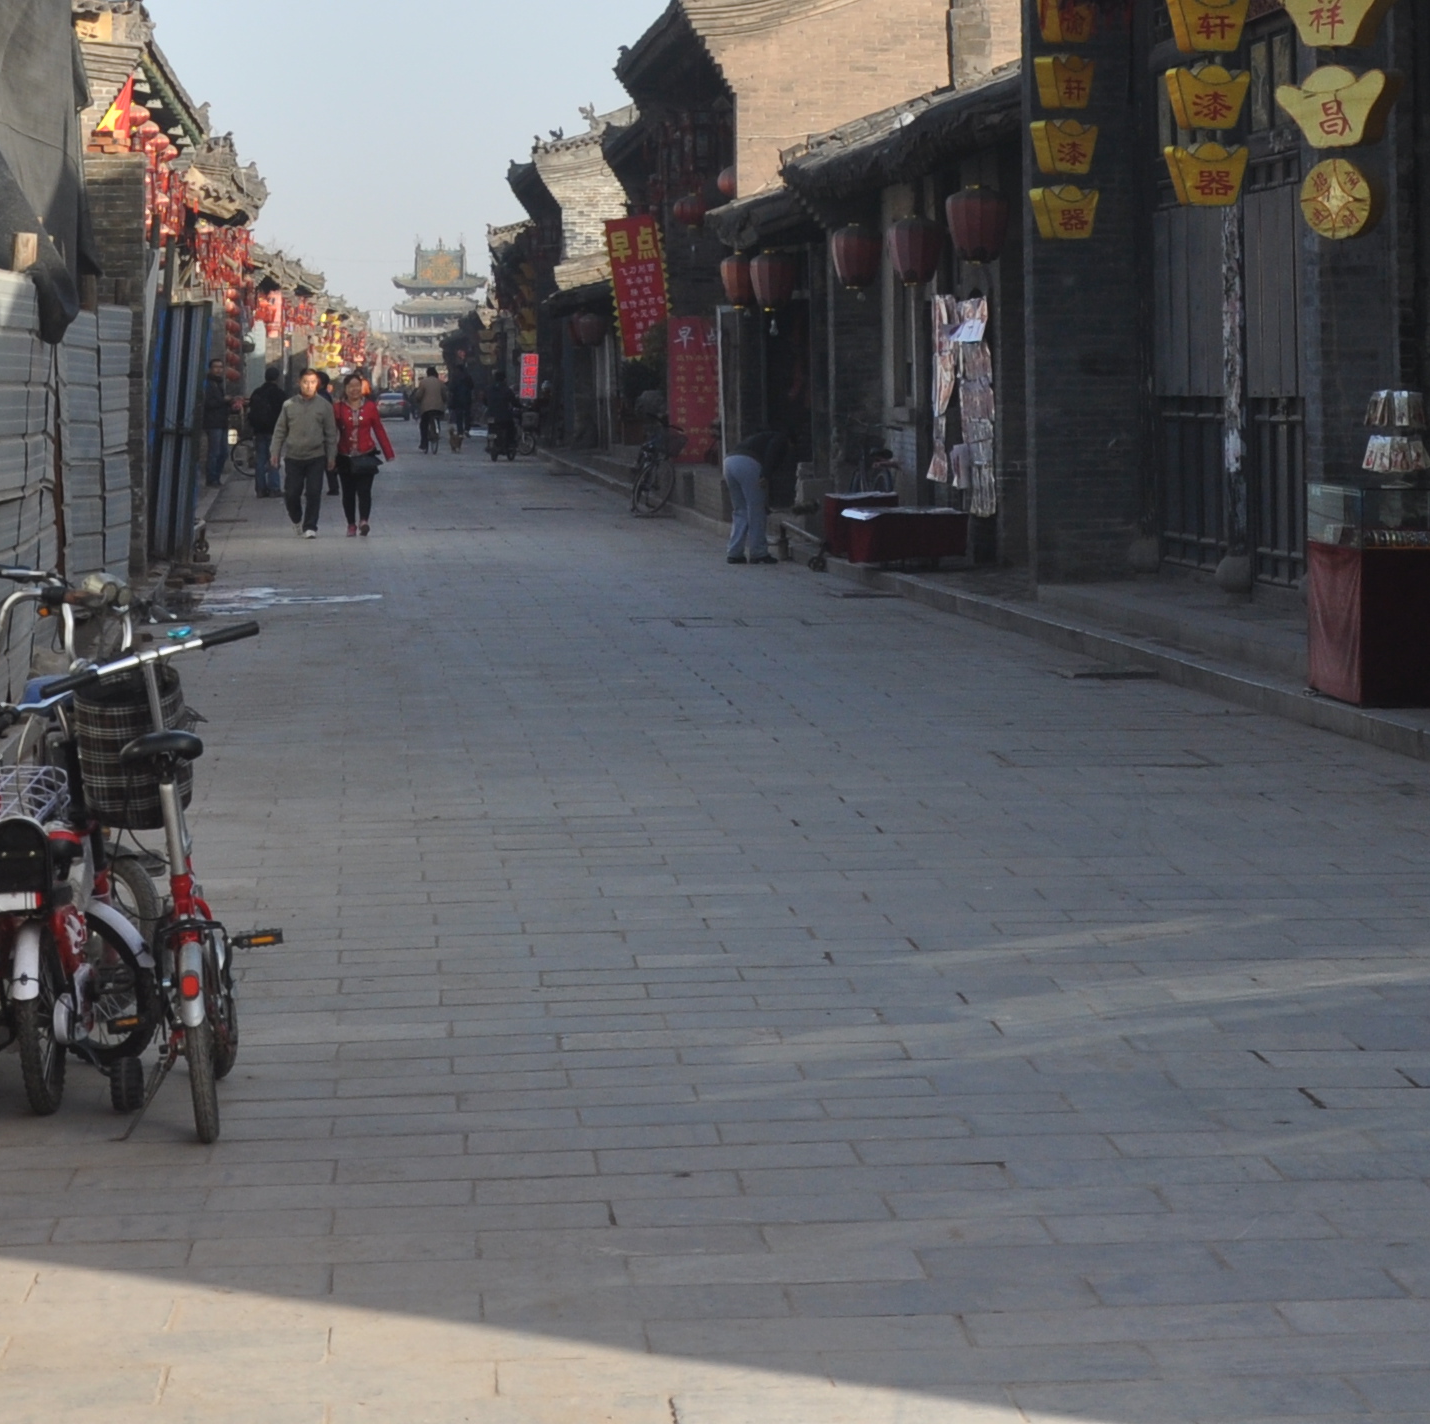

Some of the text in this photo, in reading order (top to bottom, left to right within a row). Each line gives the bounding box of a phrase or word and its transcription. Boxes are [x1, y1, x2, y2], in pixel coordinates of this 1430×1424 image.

[1056, 10, 1089, 233] 谕轩漆器
[610, 226, 658, 263] 早点
